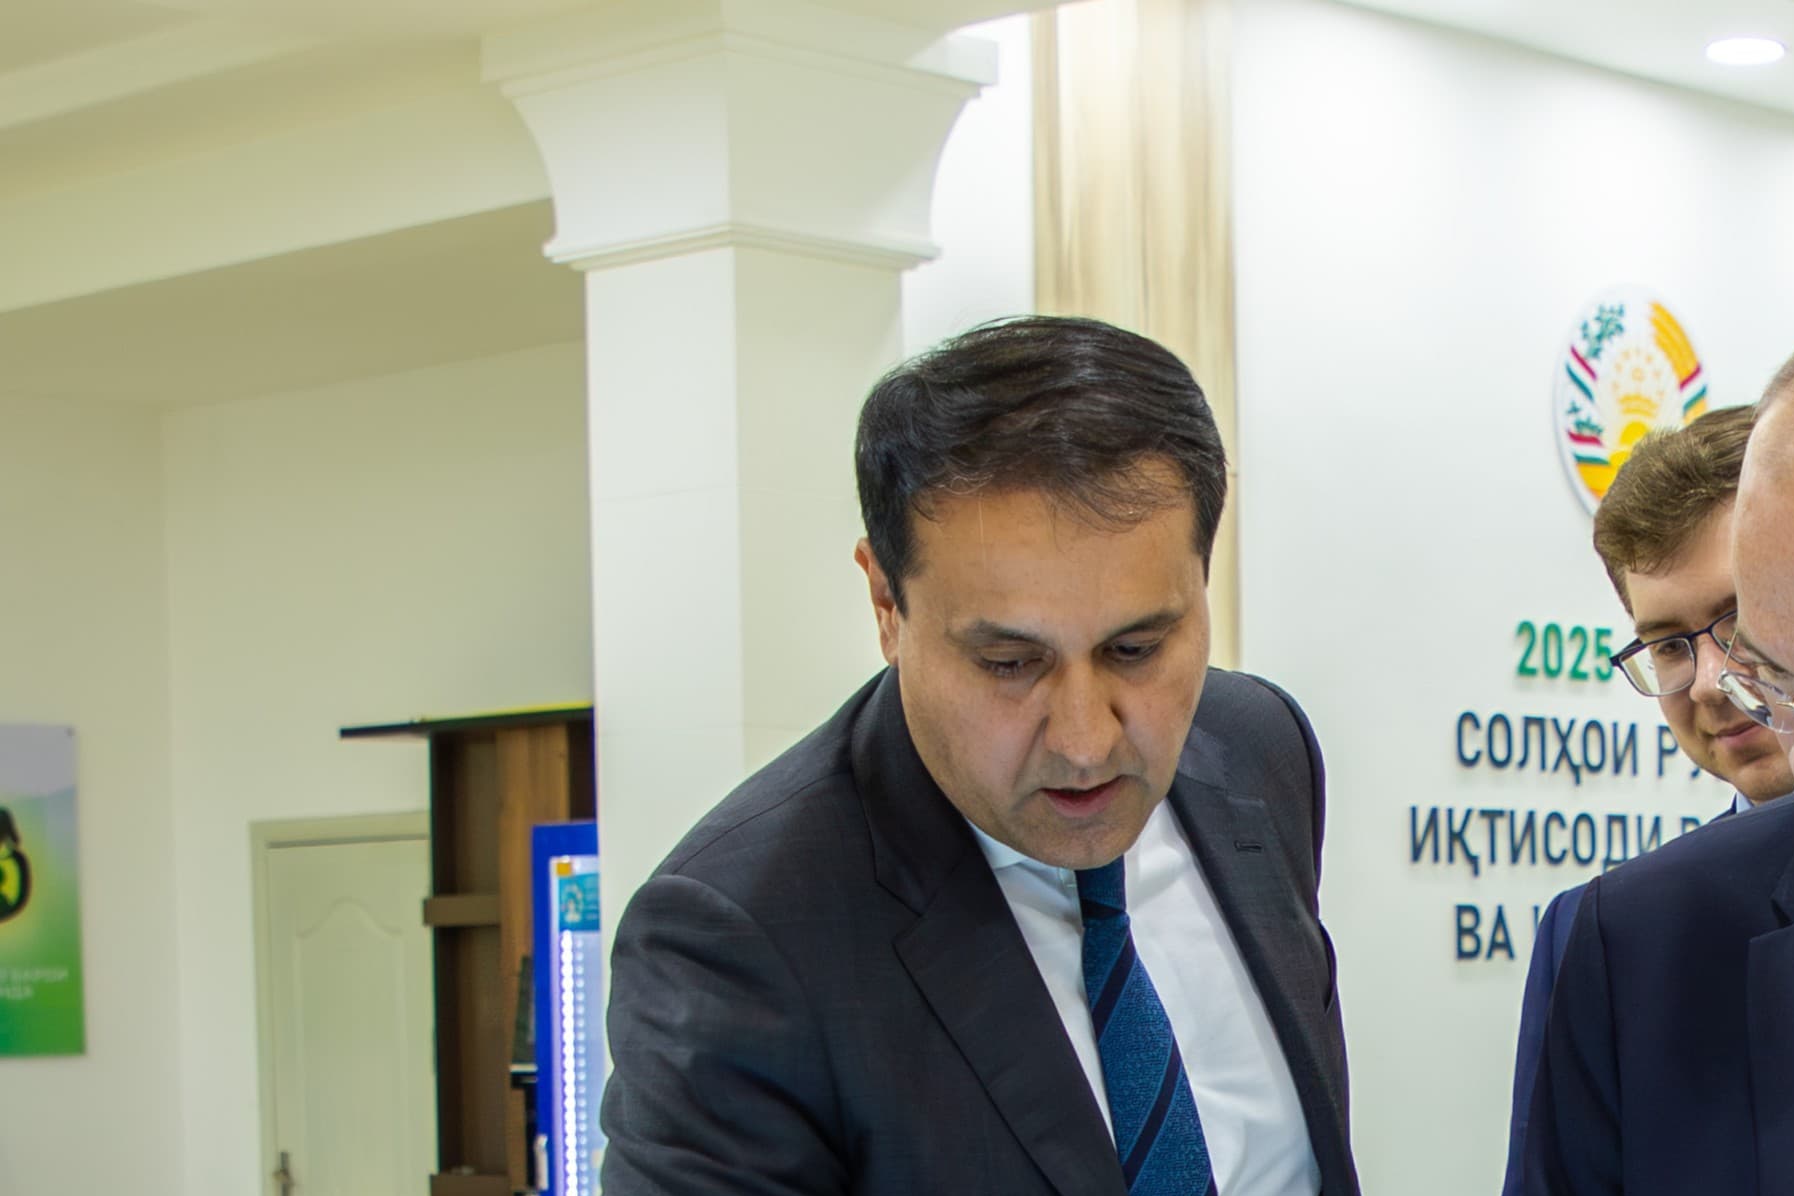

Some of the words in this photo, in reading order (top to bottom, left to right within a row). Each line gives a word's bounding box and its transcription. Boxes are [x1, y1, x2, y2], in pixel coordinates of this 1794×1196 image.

[1516, 620, 1613, 681] 2025
[1456, 711, 1638, 786] СОЛҲОИ
[1410, 805, 1662, 876] ИҚТИСОДИ
[1455, 904, 1515, 961] ВА
